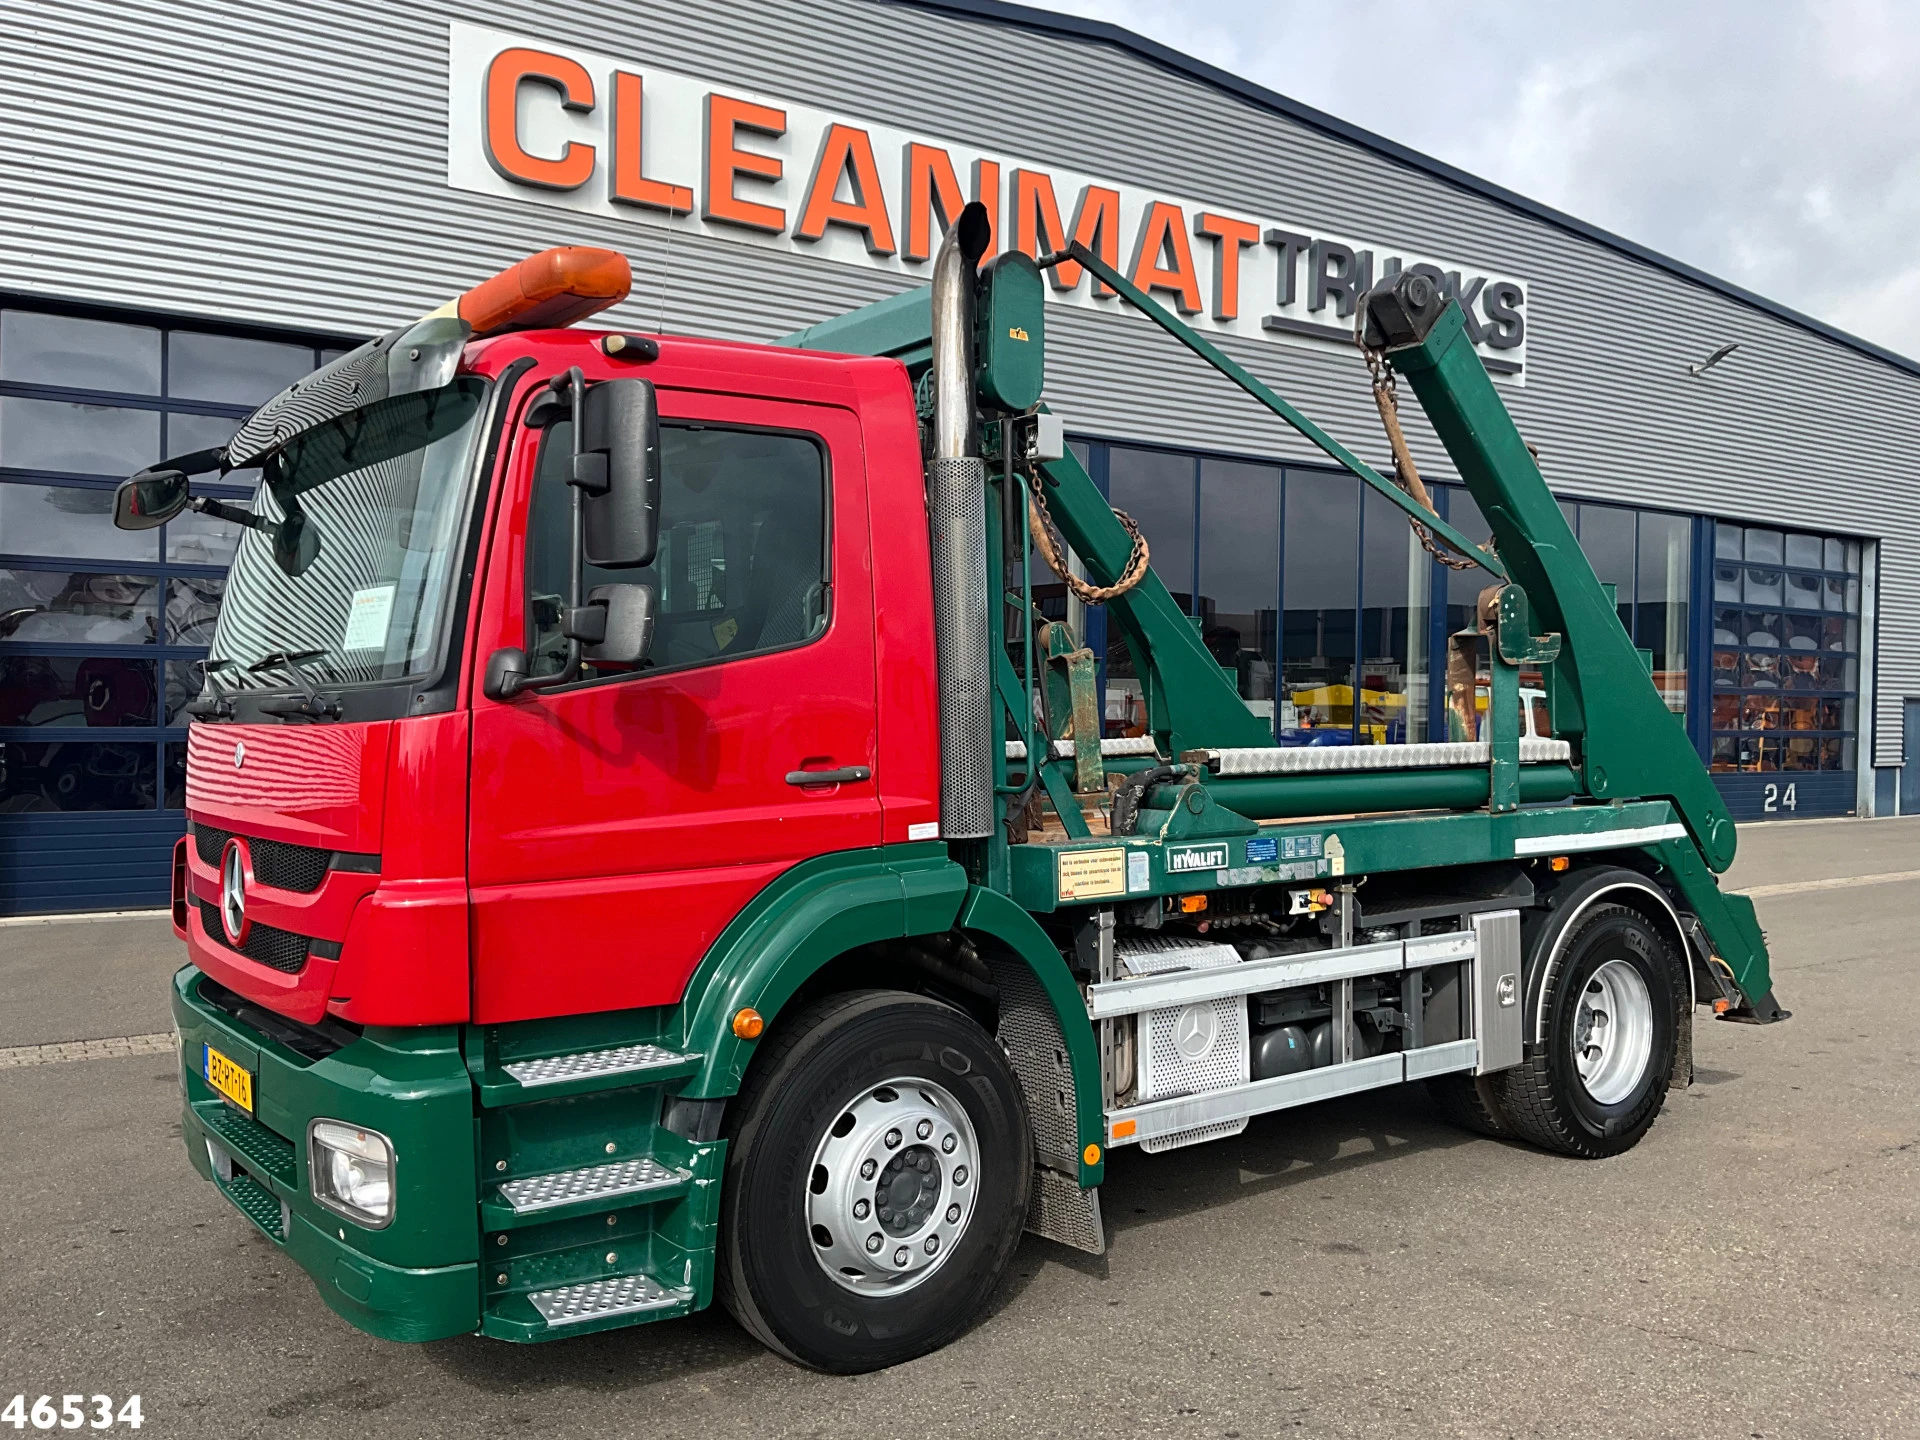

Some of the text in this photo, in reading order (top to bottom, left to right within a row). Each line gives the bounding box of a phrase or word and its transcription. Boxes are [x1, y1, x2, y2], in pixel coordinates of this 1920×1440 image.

[482, 47, 1260, 321] CLEANMAT
[1764, 783, 1797, 812] 24
[1173, 849, 1223, 869] HYVALIFT
[212, 1054, 247, 1103] BZ-RT-16
